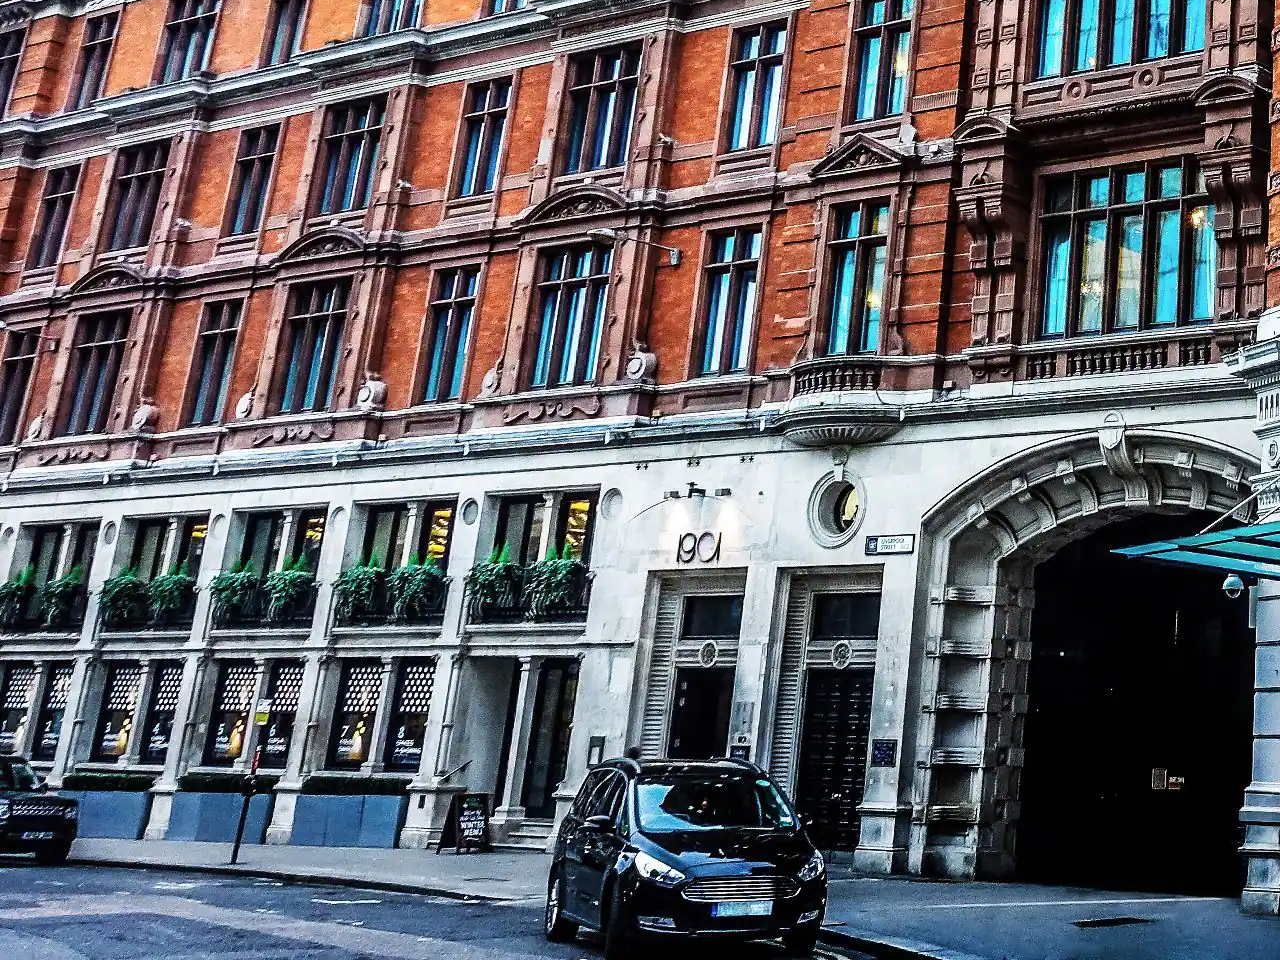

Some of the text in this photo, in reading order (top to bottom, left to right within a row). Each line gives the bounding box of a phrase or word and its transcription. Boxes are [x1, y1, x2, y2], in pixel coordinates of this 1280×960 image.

[676, 531, 722, 564] 1901
[104, 722, 112, 733] 3
[152, 722, 160, 735] 4
[217, 723, 225, 736] 5
[269, 724, 276, 737] 6
[340, 725, 350, 738] 7
[397, 725, 405, 739] 8
